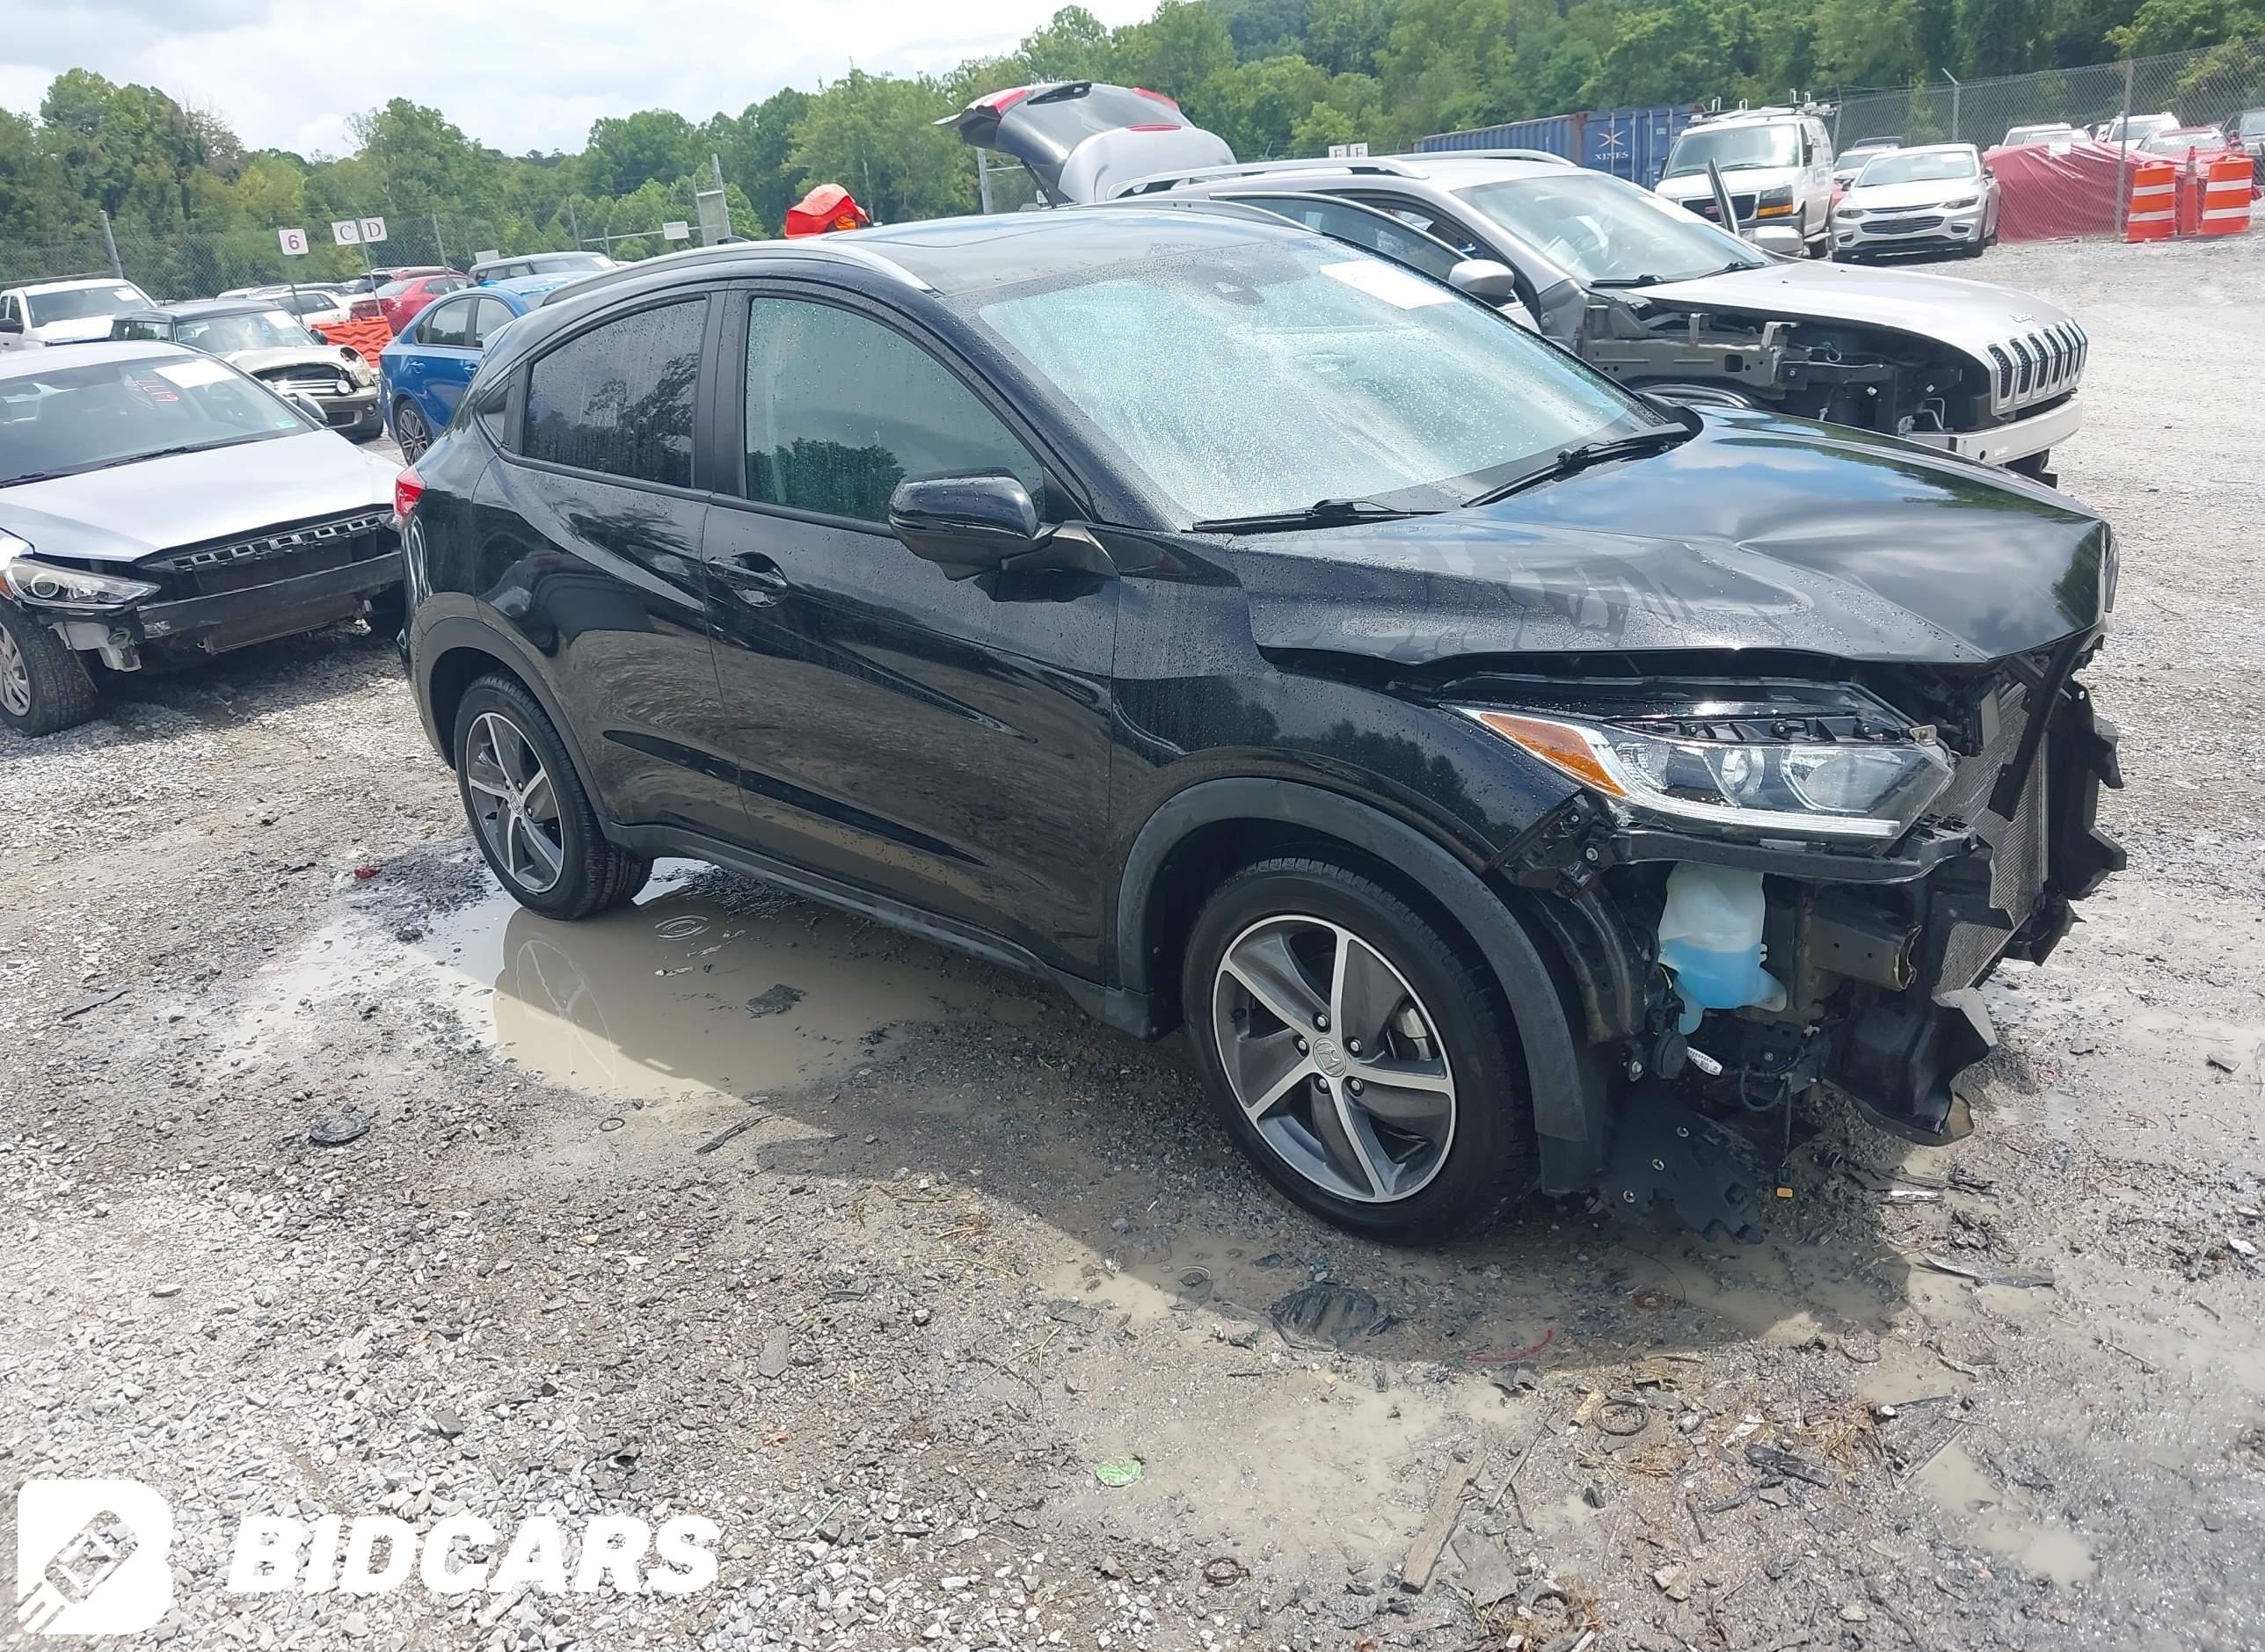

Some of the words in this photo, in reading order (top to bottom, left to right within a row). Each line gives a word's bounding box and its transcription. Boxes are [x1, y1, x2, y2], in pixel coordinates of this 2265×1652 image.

[339, 225, 353, 240] C
[366, 222, 382, 238] D
[288, 234, 300, 250] 6
